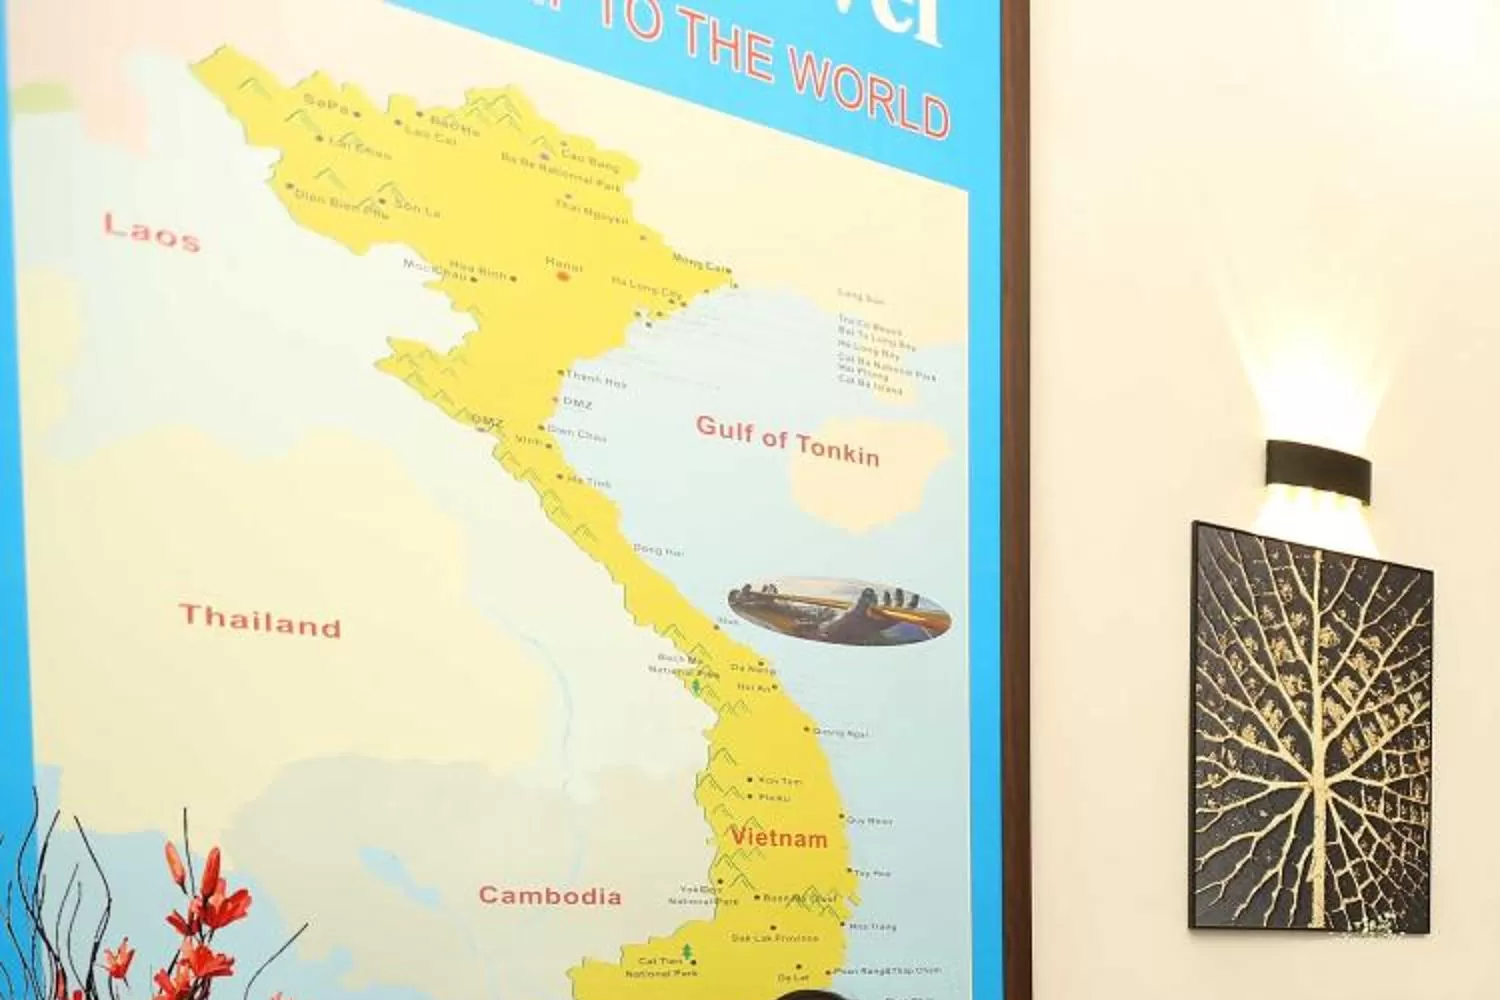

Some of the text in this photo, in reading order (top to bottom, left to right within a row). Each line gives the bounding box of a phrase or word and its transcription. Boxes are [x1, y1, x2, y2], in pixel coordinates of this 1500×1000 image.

[677, 6, 774, 83] THE
[787, 46, 952, 140] WORLD
[103, 212, 201, 254] Laos
[695, 414, 881, 468] Gulf of Tonkin
[178, 602, 342, 640] Thailand
[730, 826, 829, 850] Vietnam
[479, 885, 622, 907] Cambodia
